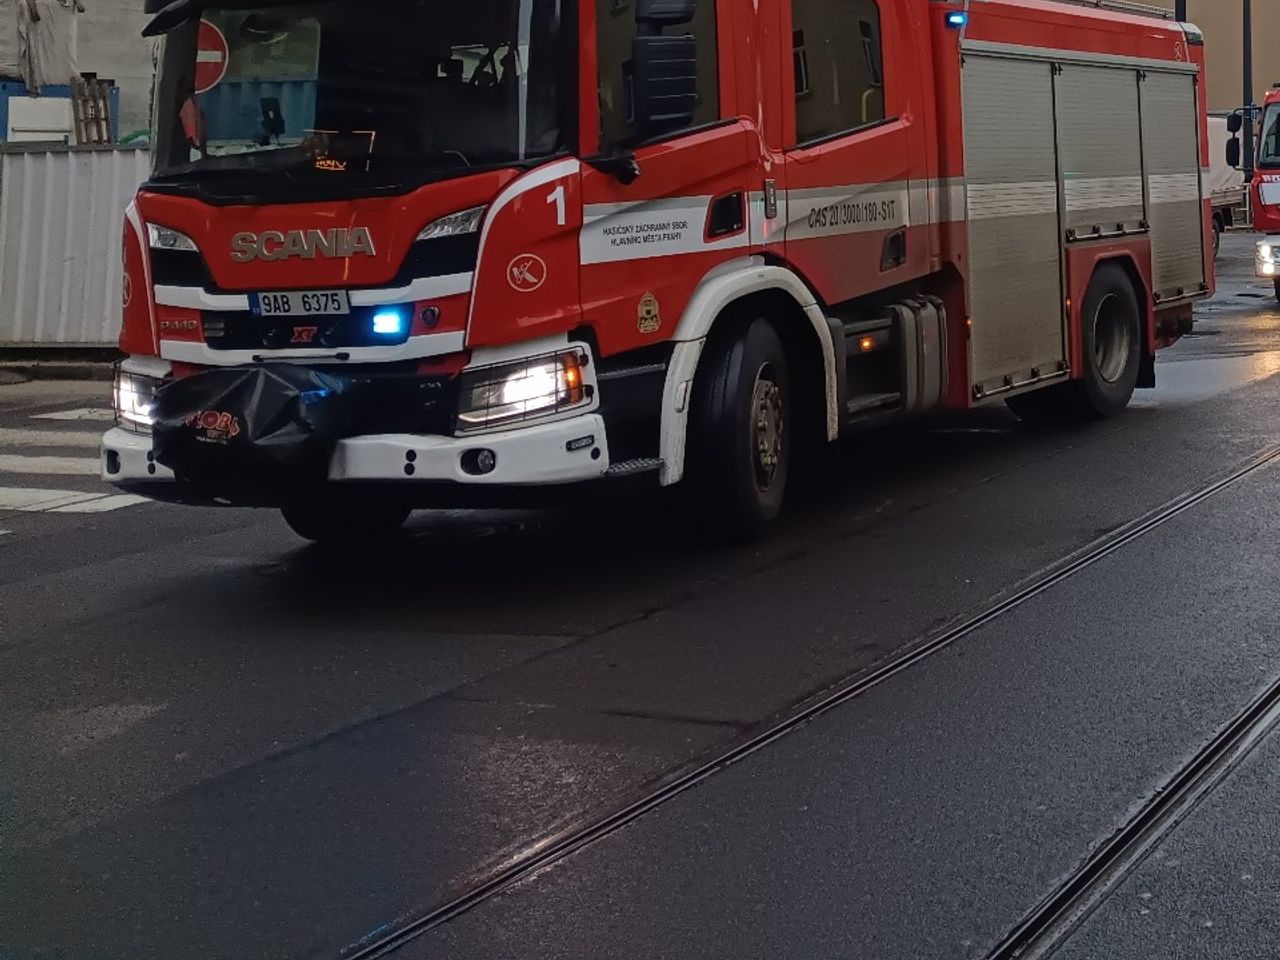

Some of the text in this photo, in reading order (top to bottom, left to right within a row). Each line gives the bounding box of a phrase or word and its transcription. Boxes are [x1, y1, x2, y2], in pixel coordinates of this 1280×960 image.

[546, 185, 566, 226] 1
[808, 207, 828, 229] CAS
[230, 226, 376, 262] SCANIA
[261, 290, 342, 314] 9AB 6375
